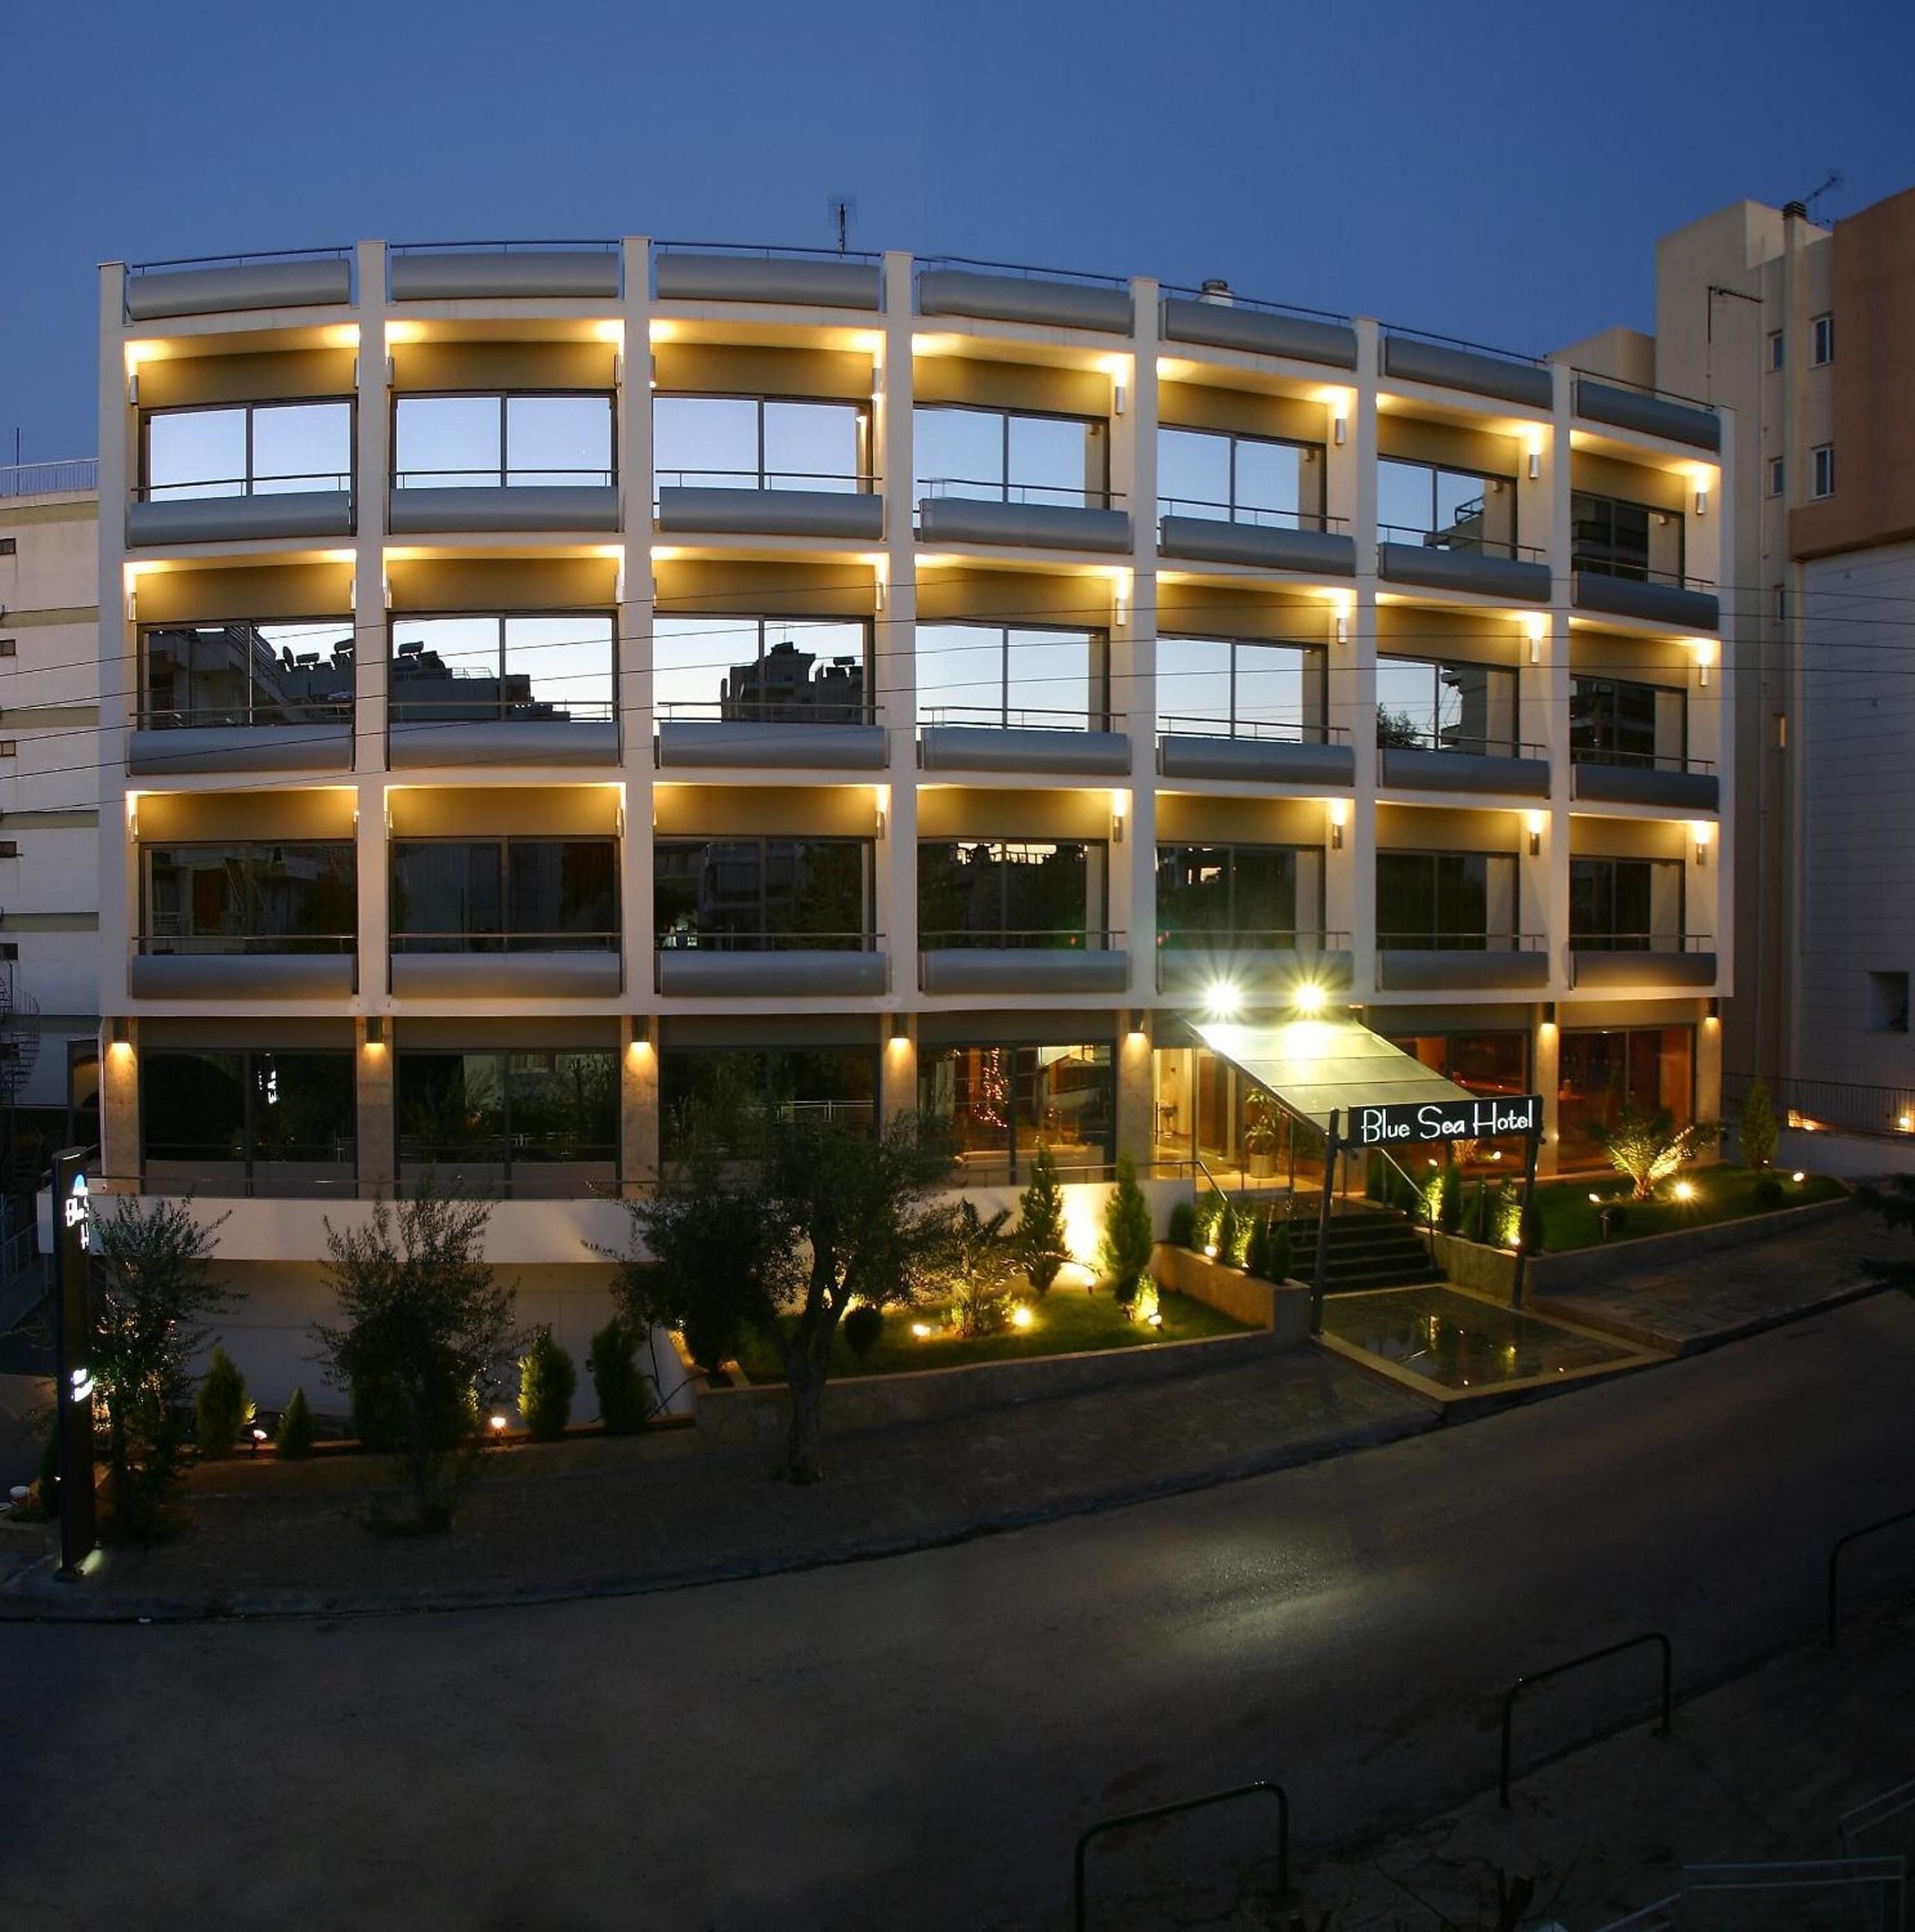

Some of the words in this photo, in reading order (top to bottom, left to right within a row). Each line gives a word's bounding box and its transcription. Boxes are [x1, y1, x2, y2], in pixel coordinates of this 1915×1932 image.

[1361, 1109, 1410, 1144] Blue
[1417, 1106, 1465, 1139] Sea
[1473, 1099, 1533, 1136] Hotel
